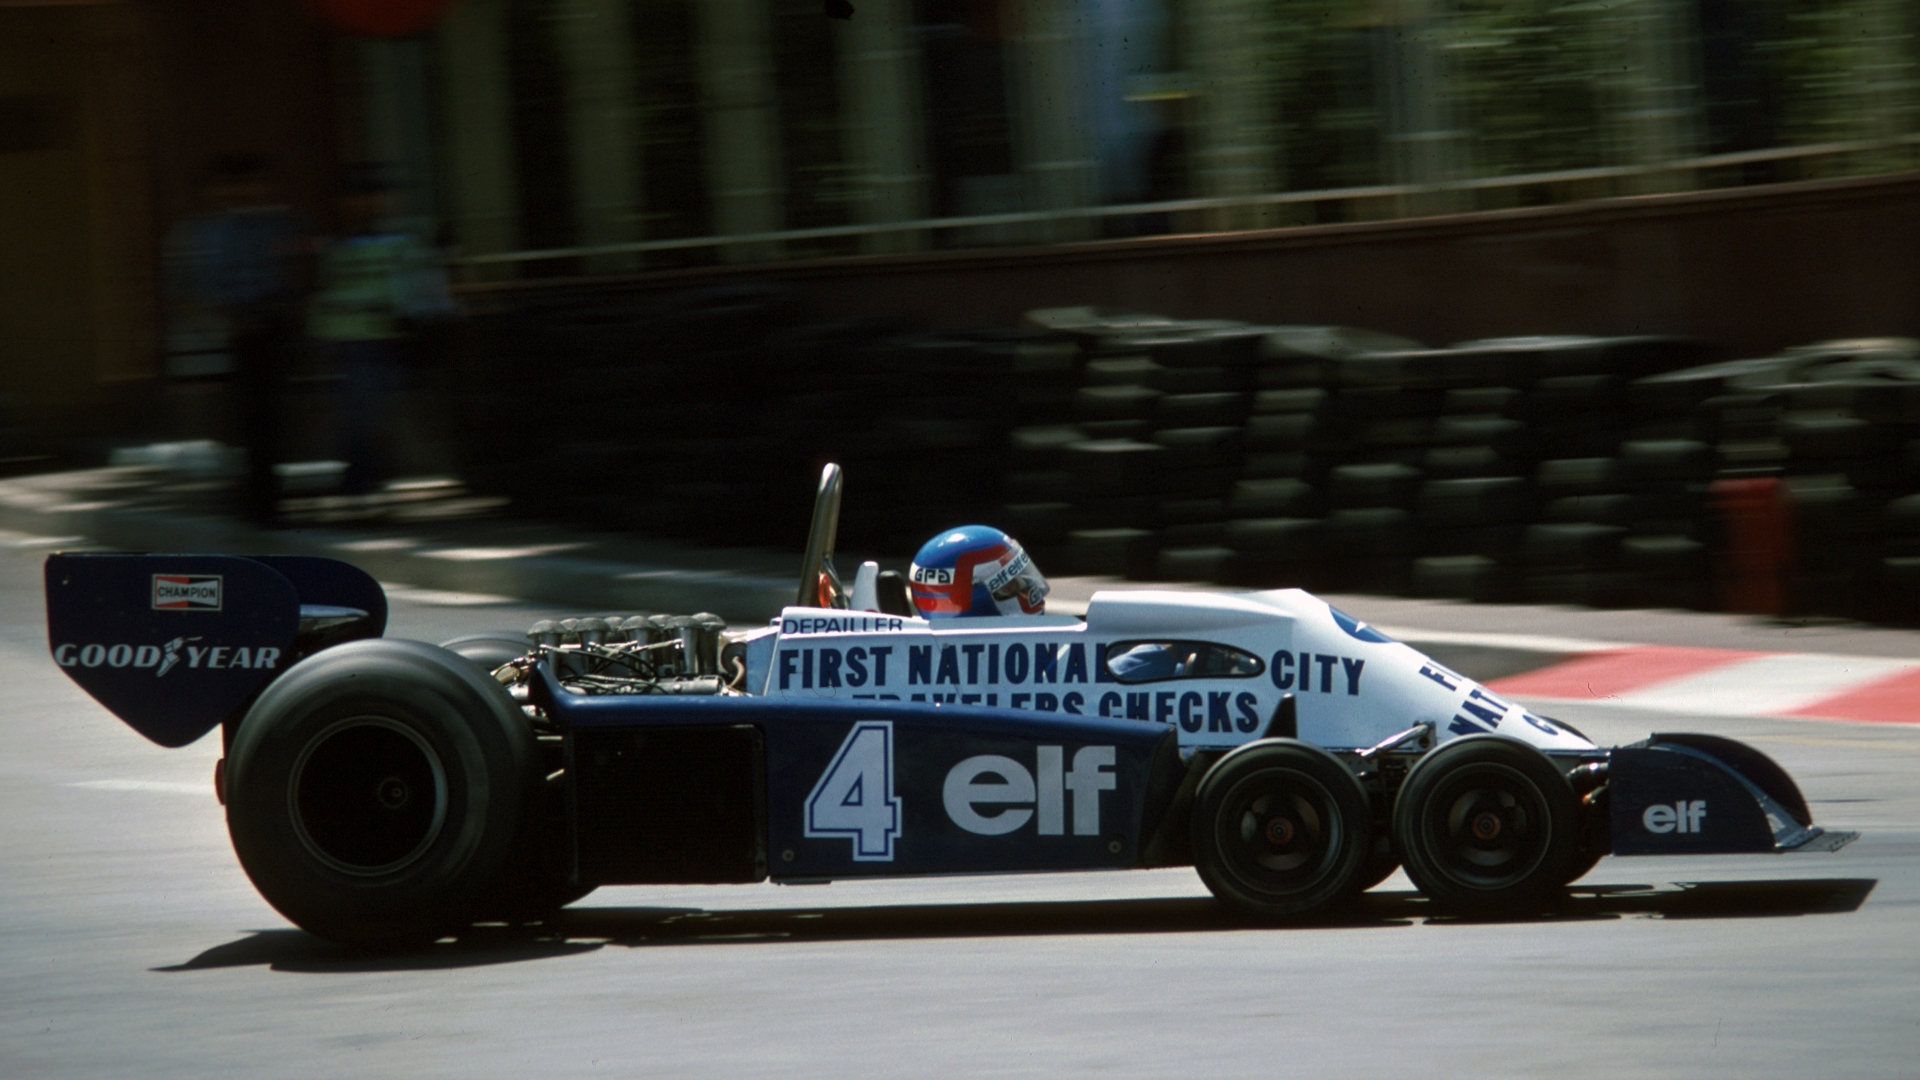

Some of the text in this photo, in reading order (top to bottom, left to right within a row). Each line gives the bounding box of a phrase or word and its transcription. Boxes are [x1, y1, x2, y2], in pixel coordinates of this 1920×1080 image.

[989, 569, 1008, 590] elf
[1008, 556, 1023, 576] elf
[158, 587, 216, 598] CHAMPION
[782, 617, 903, 635] DEPAILLER
[779, 642, 1365, 696] FIRST NATIONAL CITY
[1099, 690, 1259, 733] CHECKS
[804, 720, 902, 861] 4
[943, 745, 1117, 836] elf
[1642, 800, 1707, 834] elf
